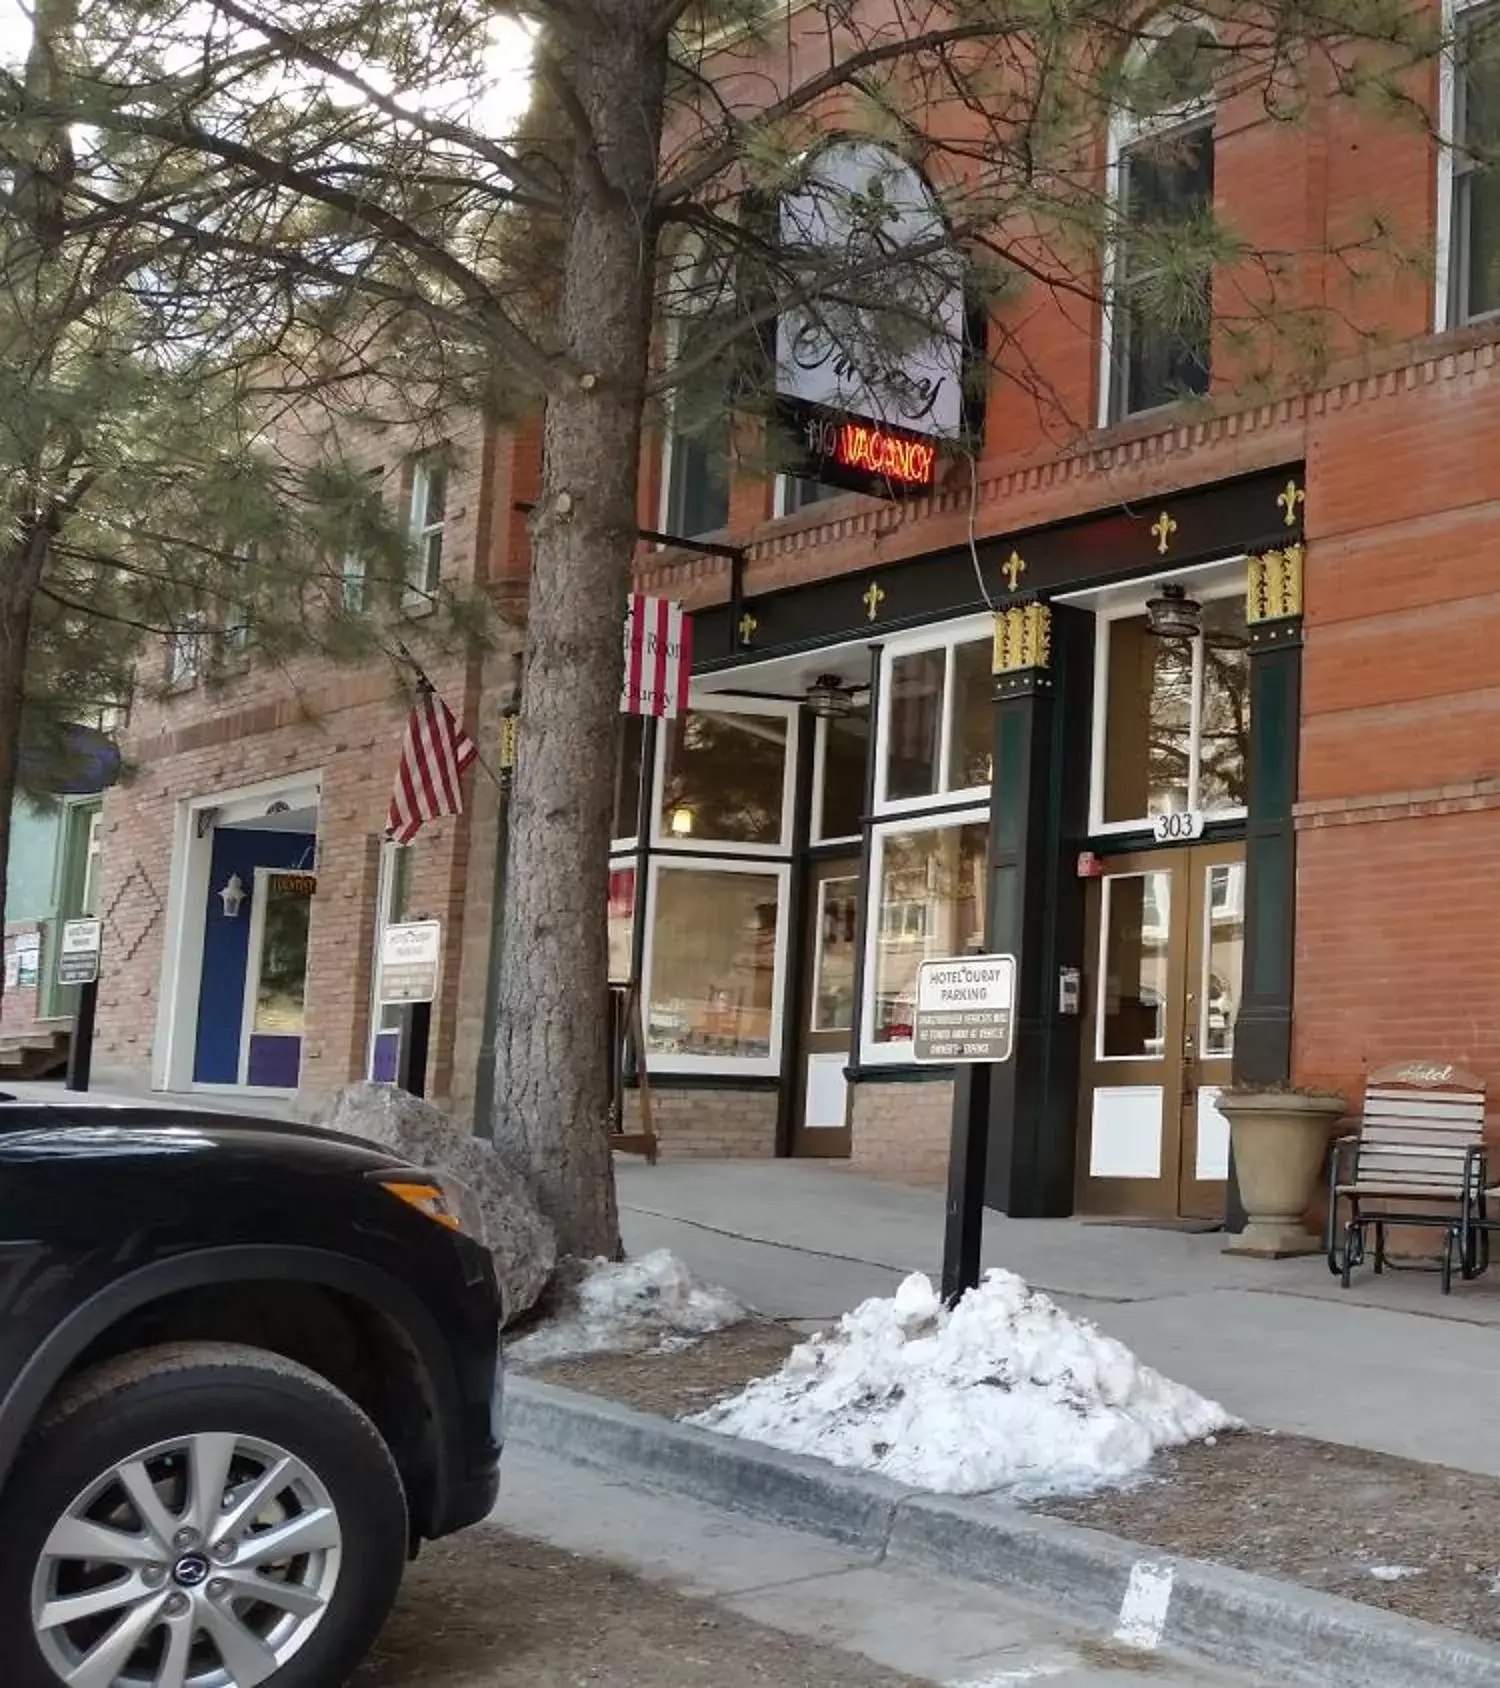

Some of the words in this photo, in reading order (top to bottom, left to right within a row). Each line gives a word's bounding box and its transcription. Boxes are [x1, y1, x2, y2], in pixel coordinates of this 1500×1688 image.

[841, 424, 935, 483] VACANCY
[1157, 813, 1193, 838] 303
[929, 970, 962, 985] HOTEL
[941, 986, 987, 1001] PARKING
